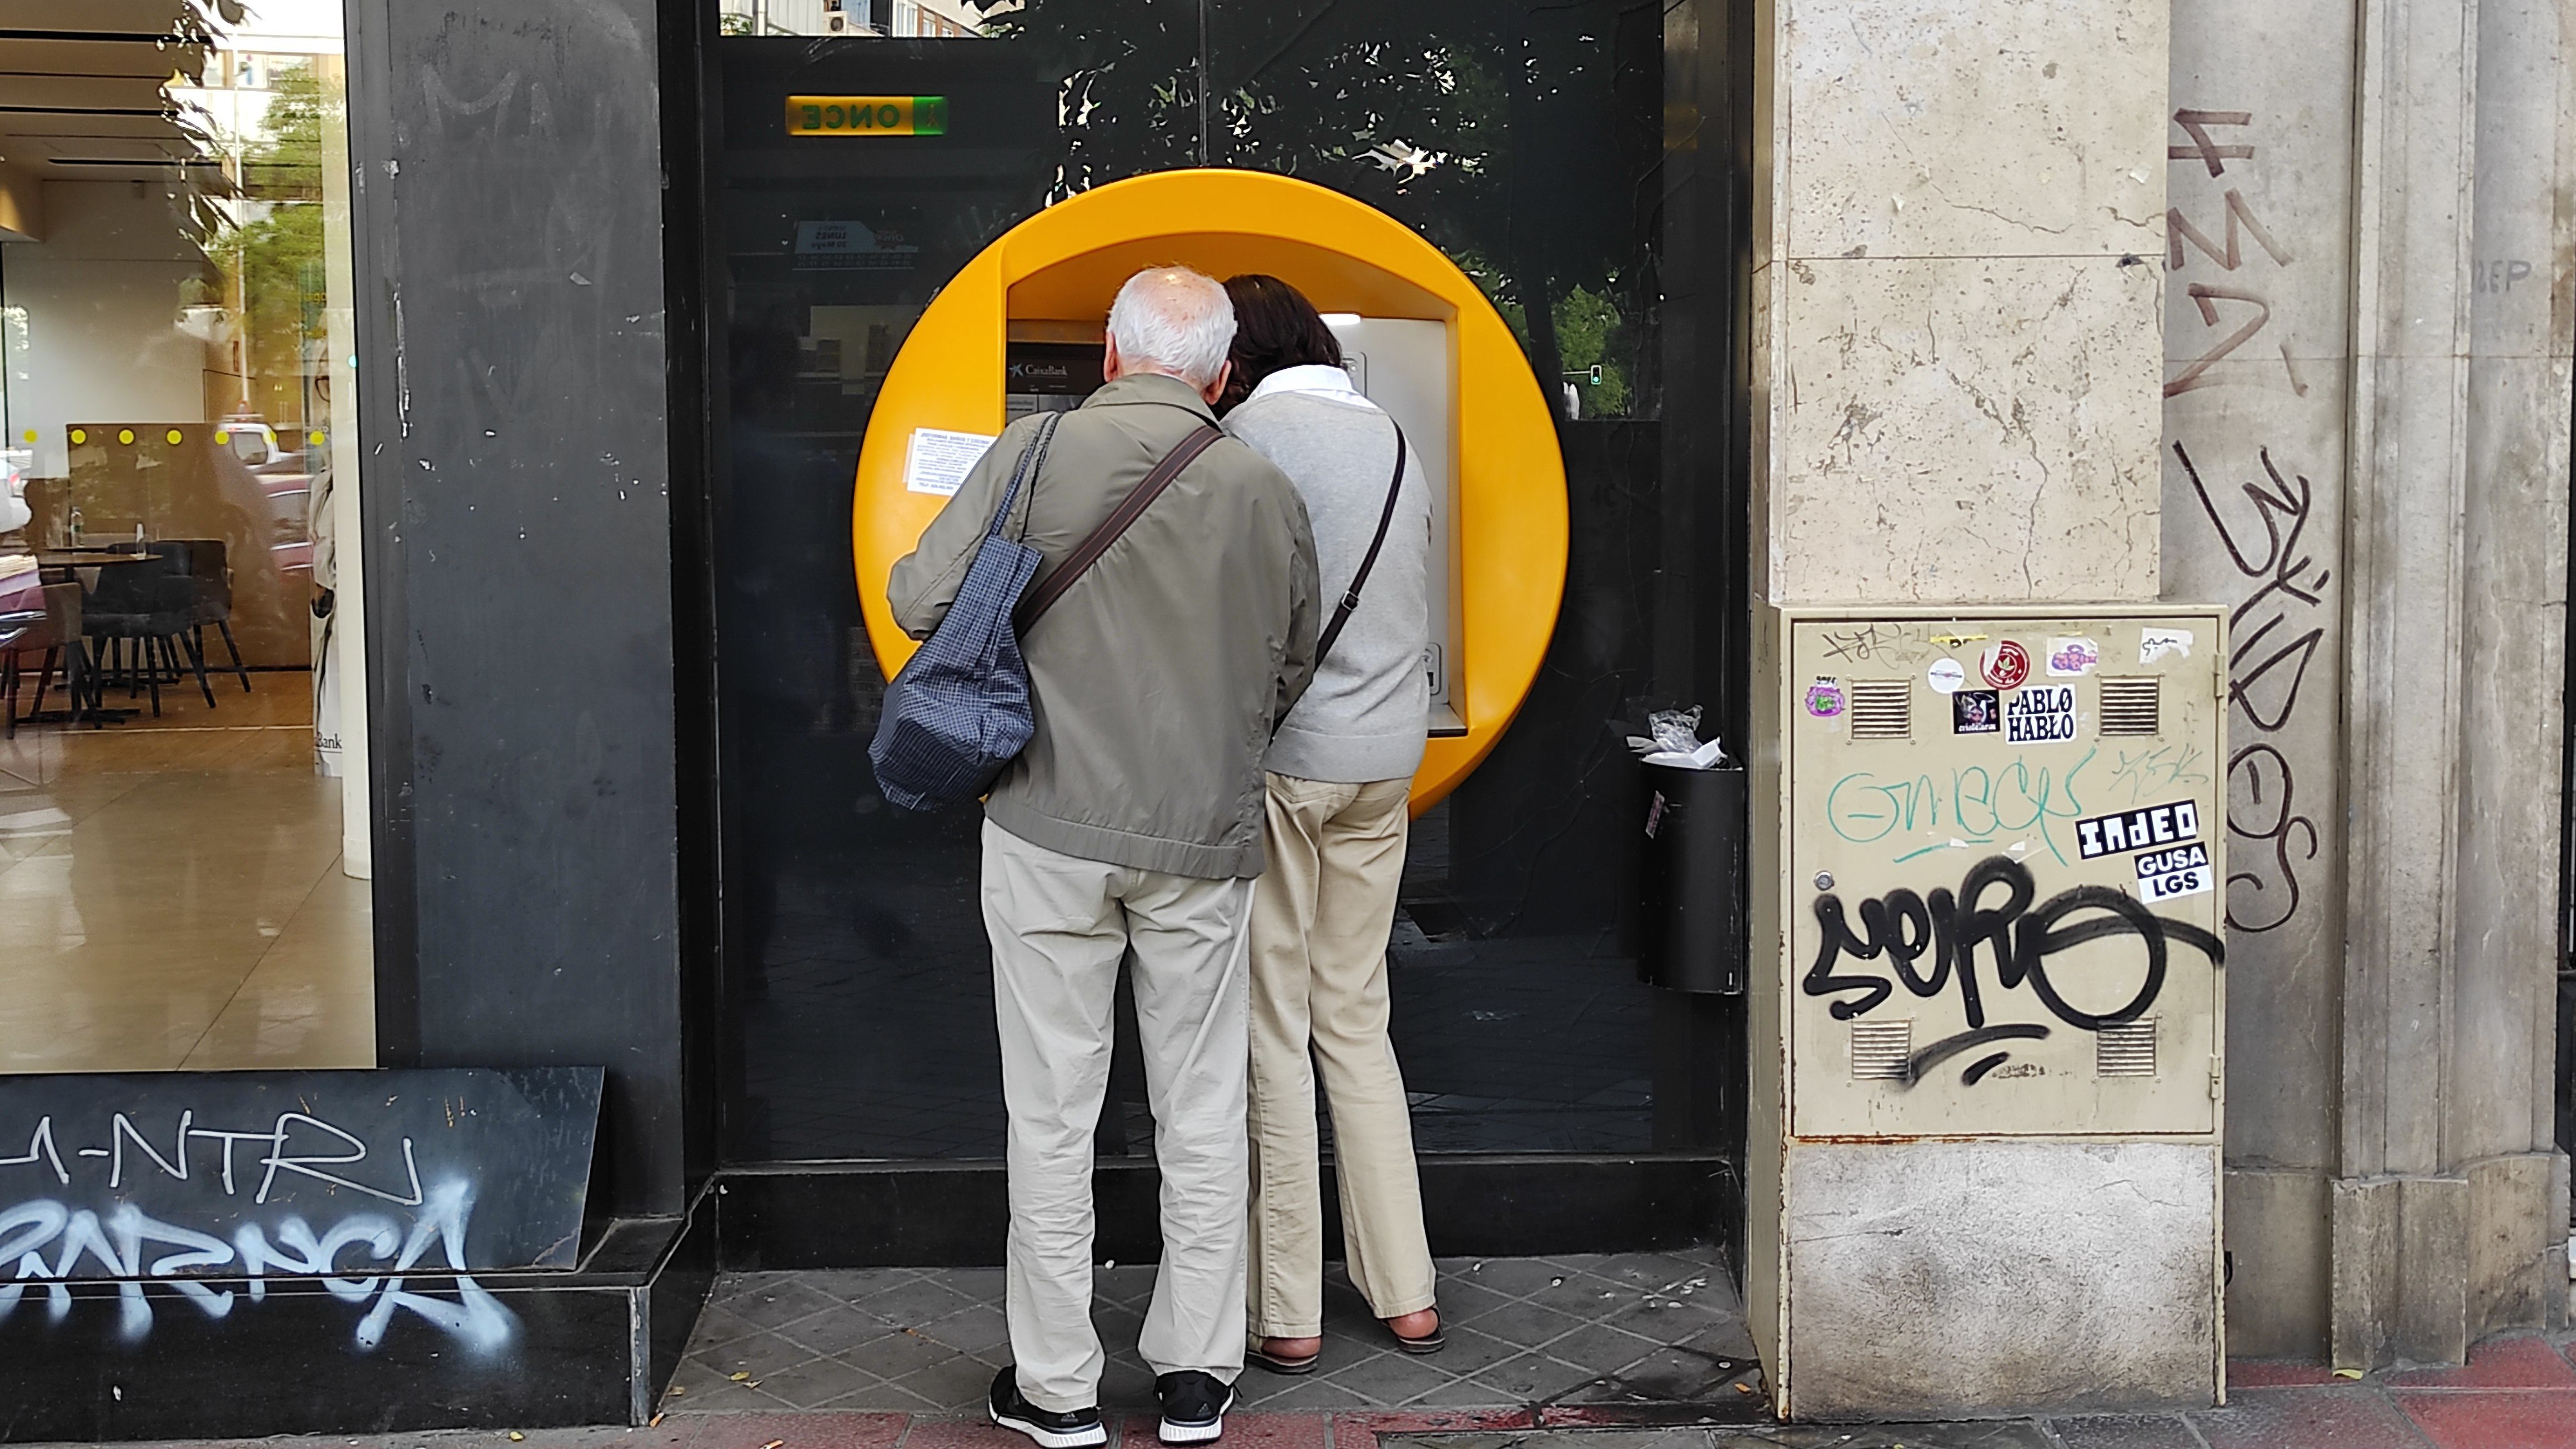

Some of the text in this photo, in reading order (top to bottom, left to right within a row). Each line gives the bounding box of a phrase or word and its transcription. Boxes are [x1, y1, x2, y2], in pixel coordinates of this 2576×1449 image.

[1025, 364, 1068, 376] CaixaBank
[2138, 846, 2206, 875] GUSA
[2152, 871, 2199, 898] LGS
